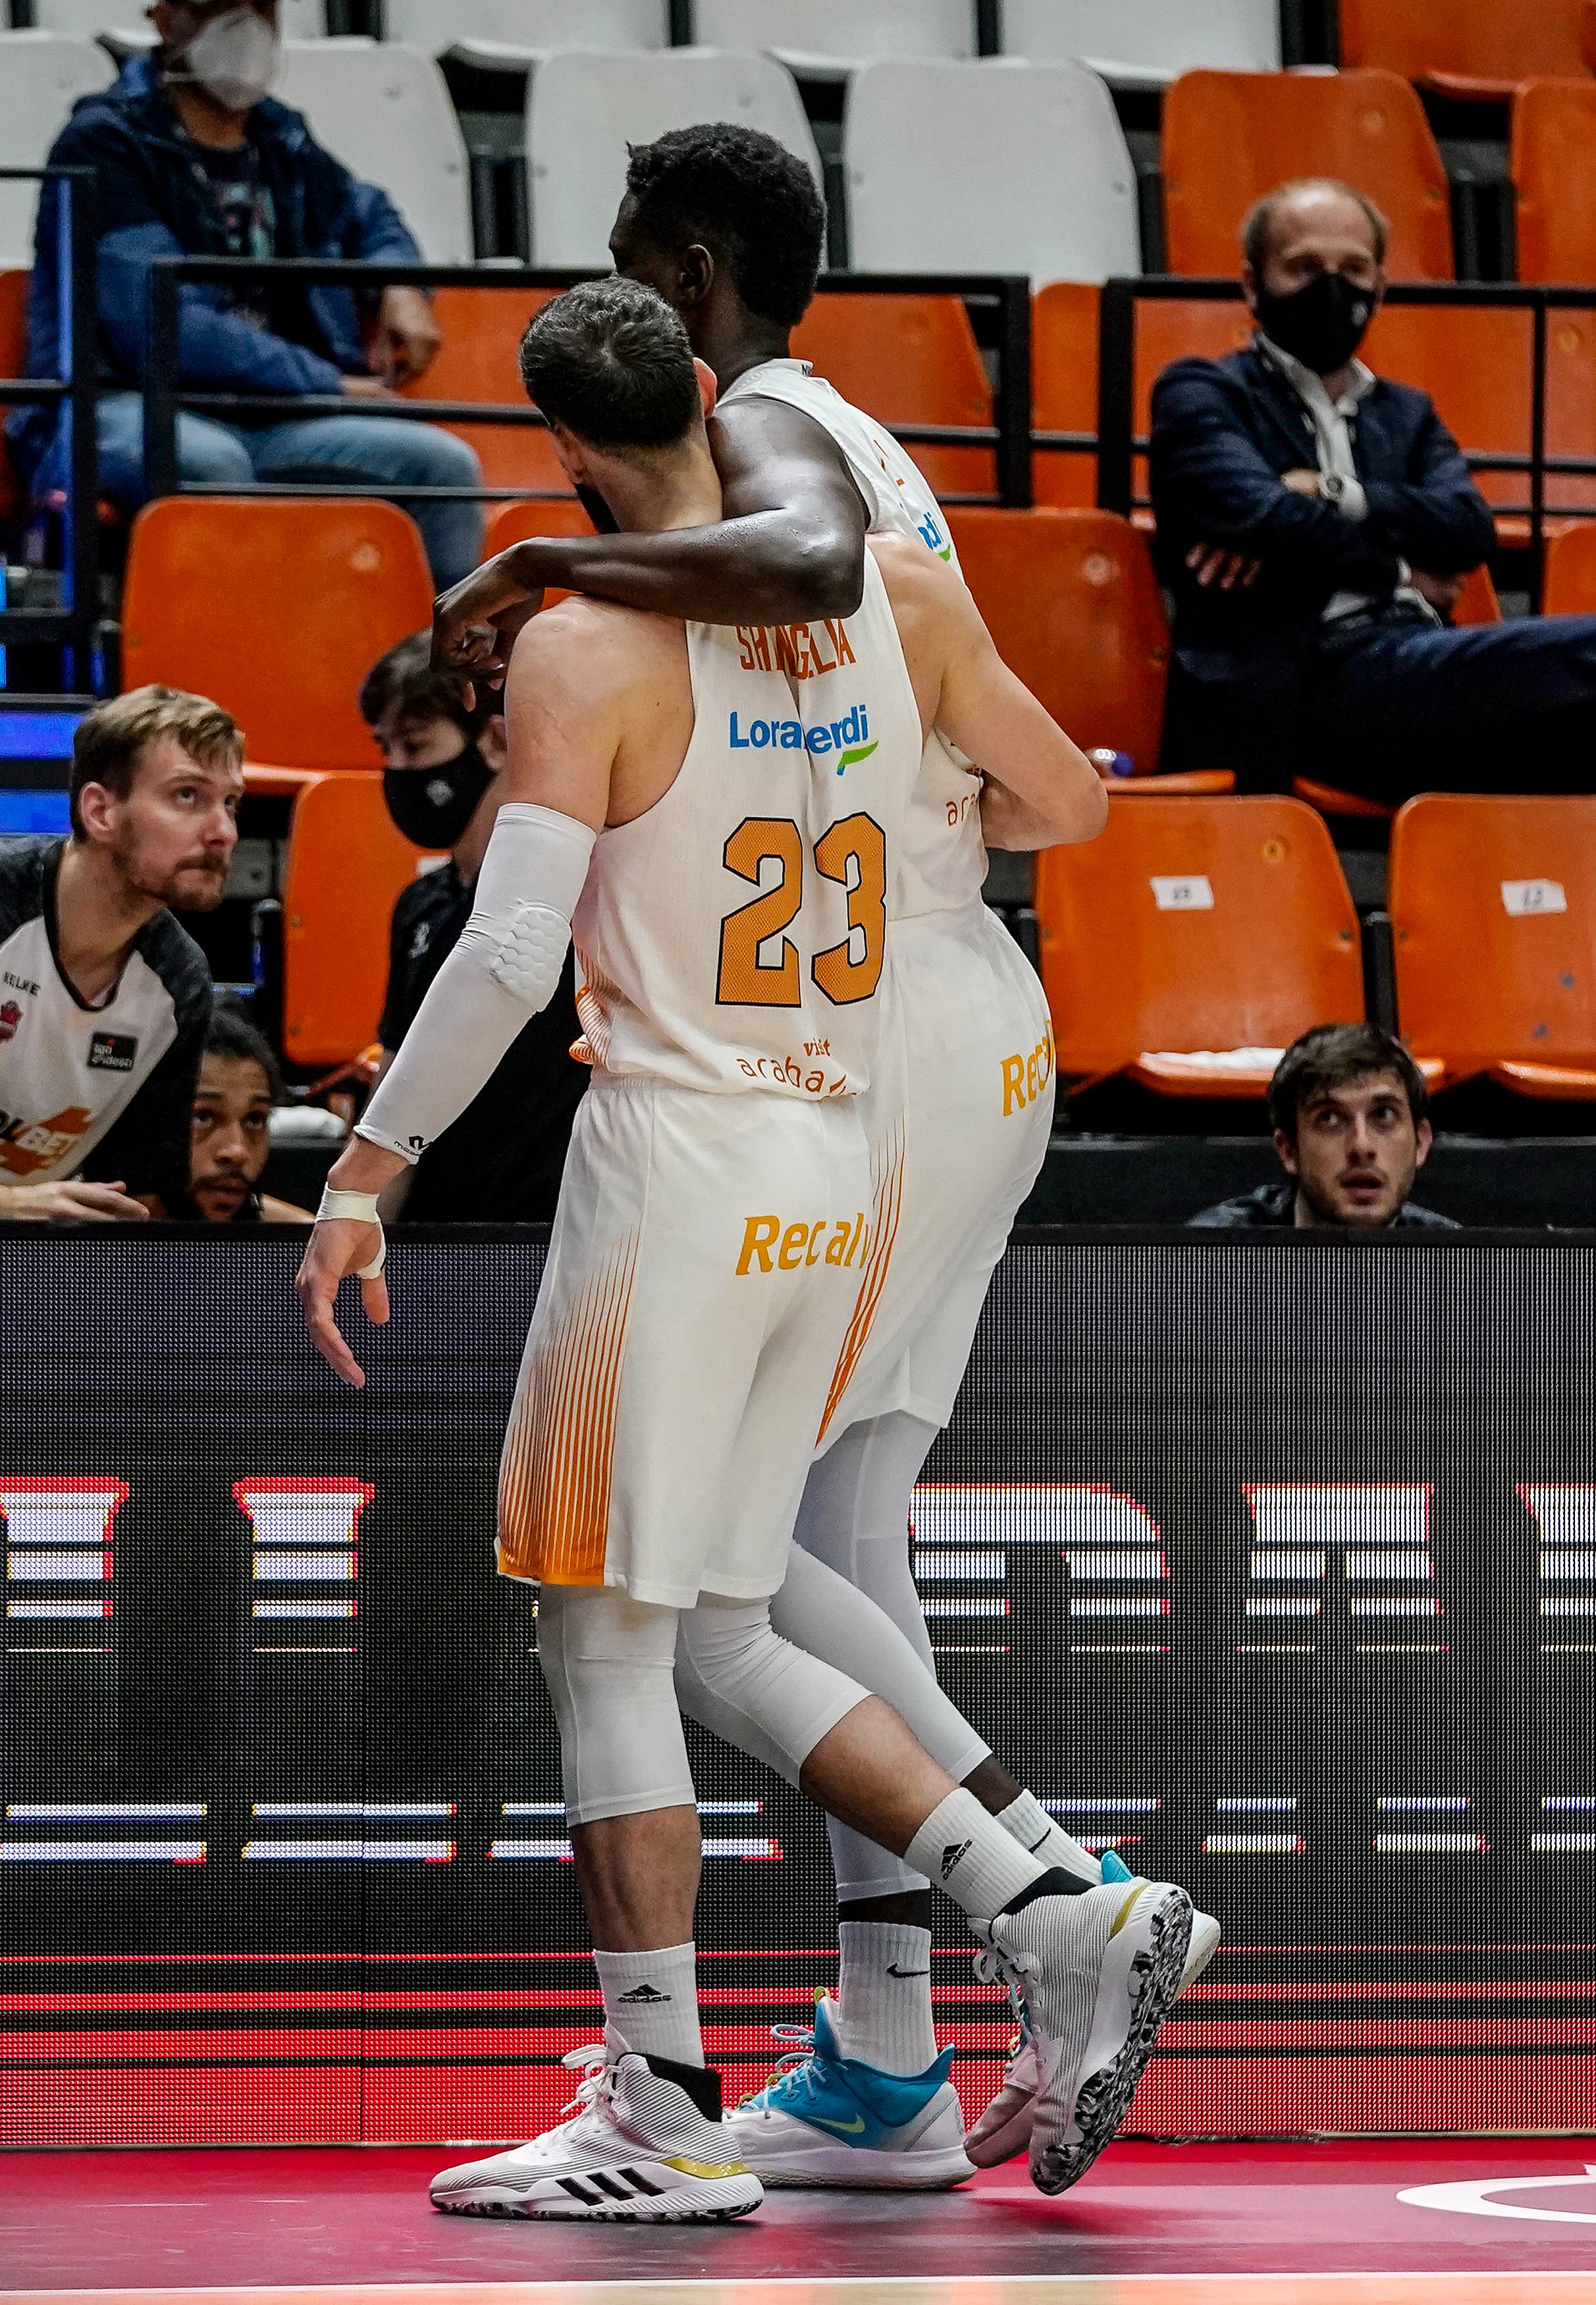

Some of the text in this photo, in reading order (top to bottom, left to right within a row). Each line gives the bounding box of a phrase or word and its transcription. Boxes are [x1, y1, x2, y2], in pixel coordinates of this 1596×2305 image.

[730, 704, 868, 754] Loraerdi
[715, 812, 886, 1008] 23
[942, 1838, 972, 1880] adidas
[618, 1993, 672, 2003] adidas
